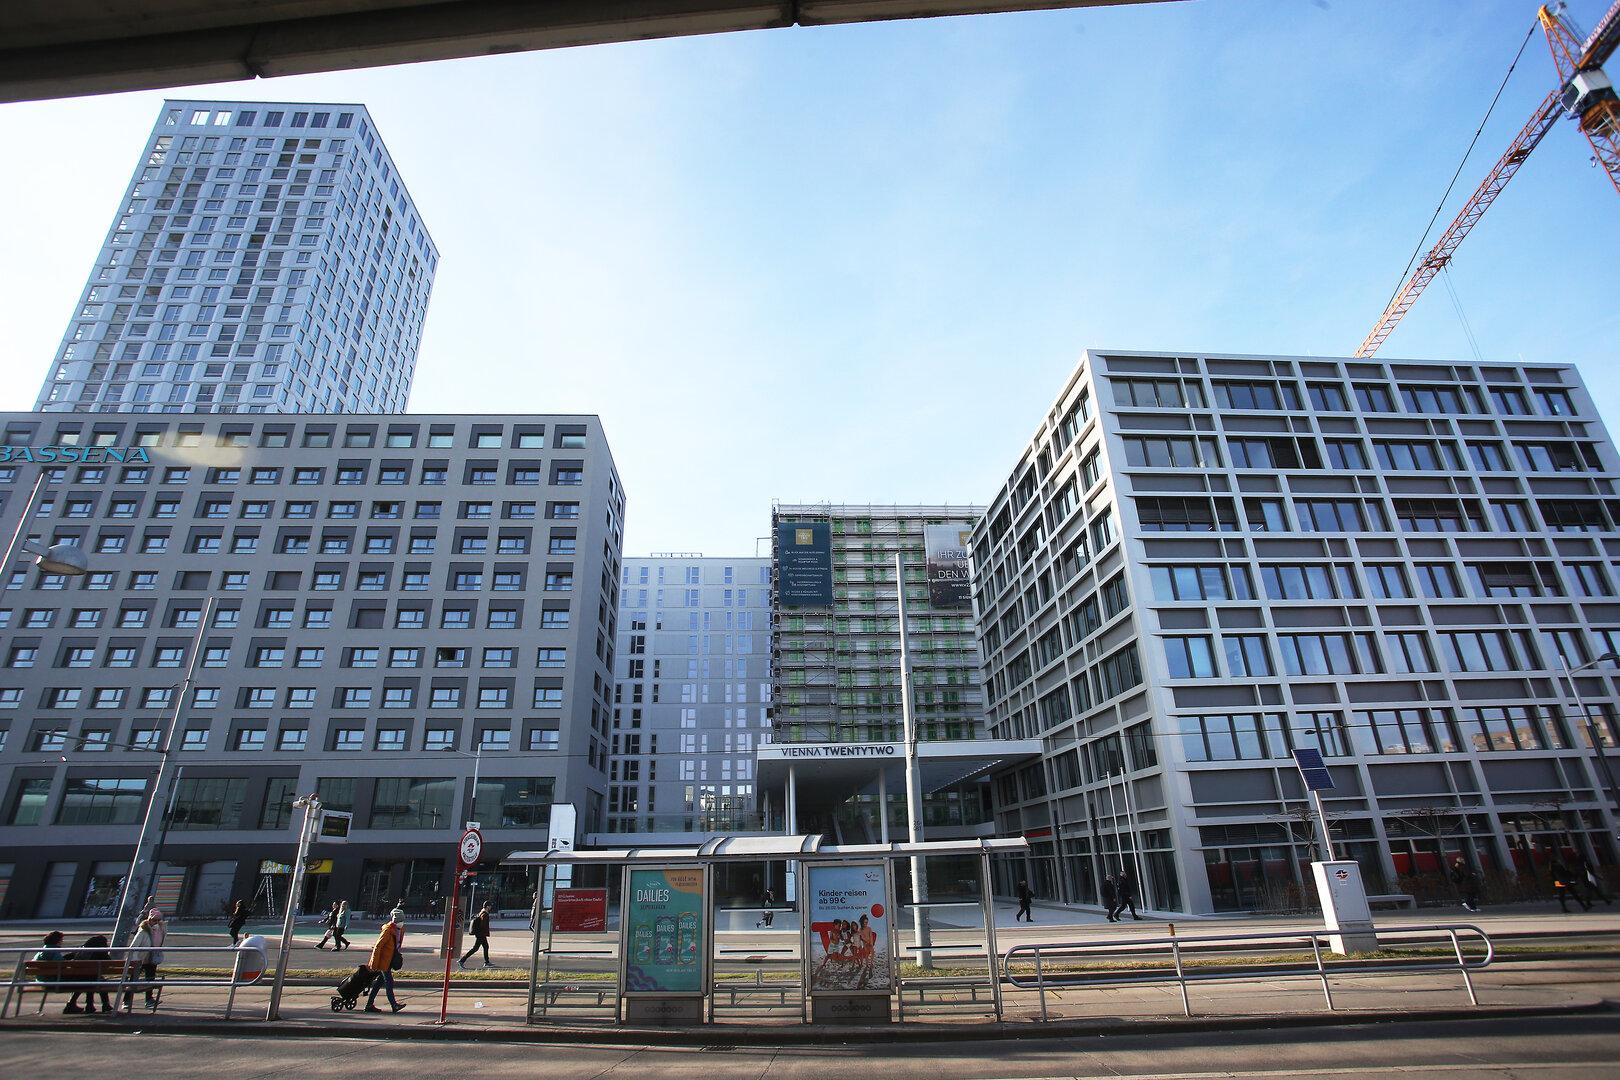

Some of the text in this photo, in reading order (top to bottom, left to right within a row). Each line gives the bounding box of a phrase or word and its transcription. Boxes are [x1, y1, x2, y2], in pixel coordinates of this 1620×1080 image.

[0, 445, 150, 463] BASSENA
[937, 550, 954, 559] IHR
[938, 570, 959, 579] DEN
[781, 745, 895, 757] VIENNA TWENTYTWO
[637, 889, 670, 902] DAILIES
